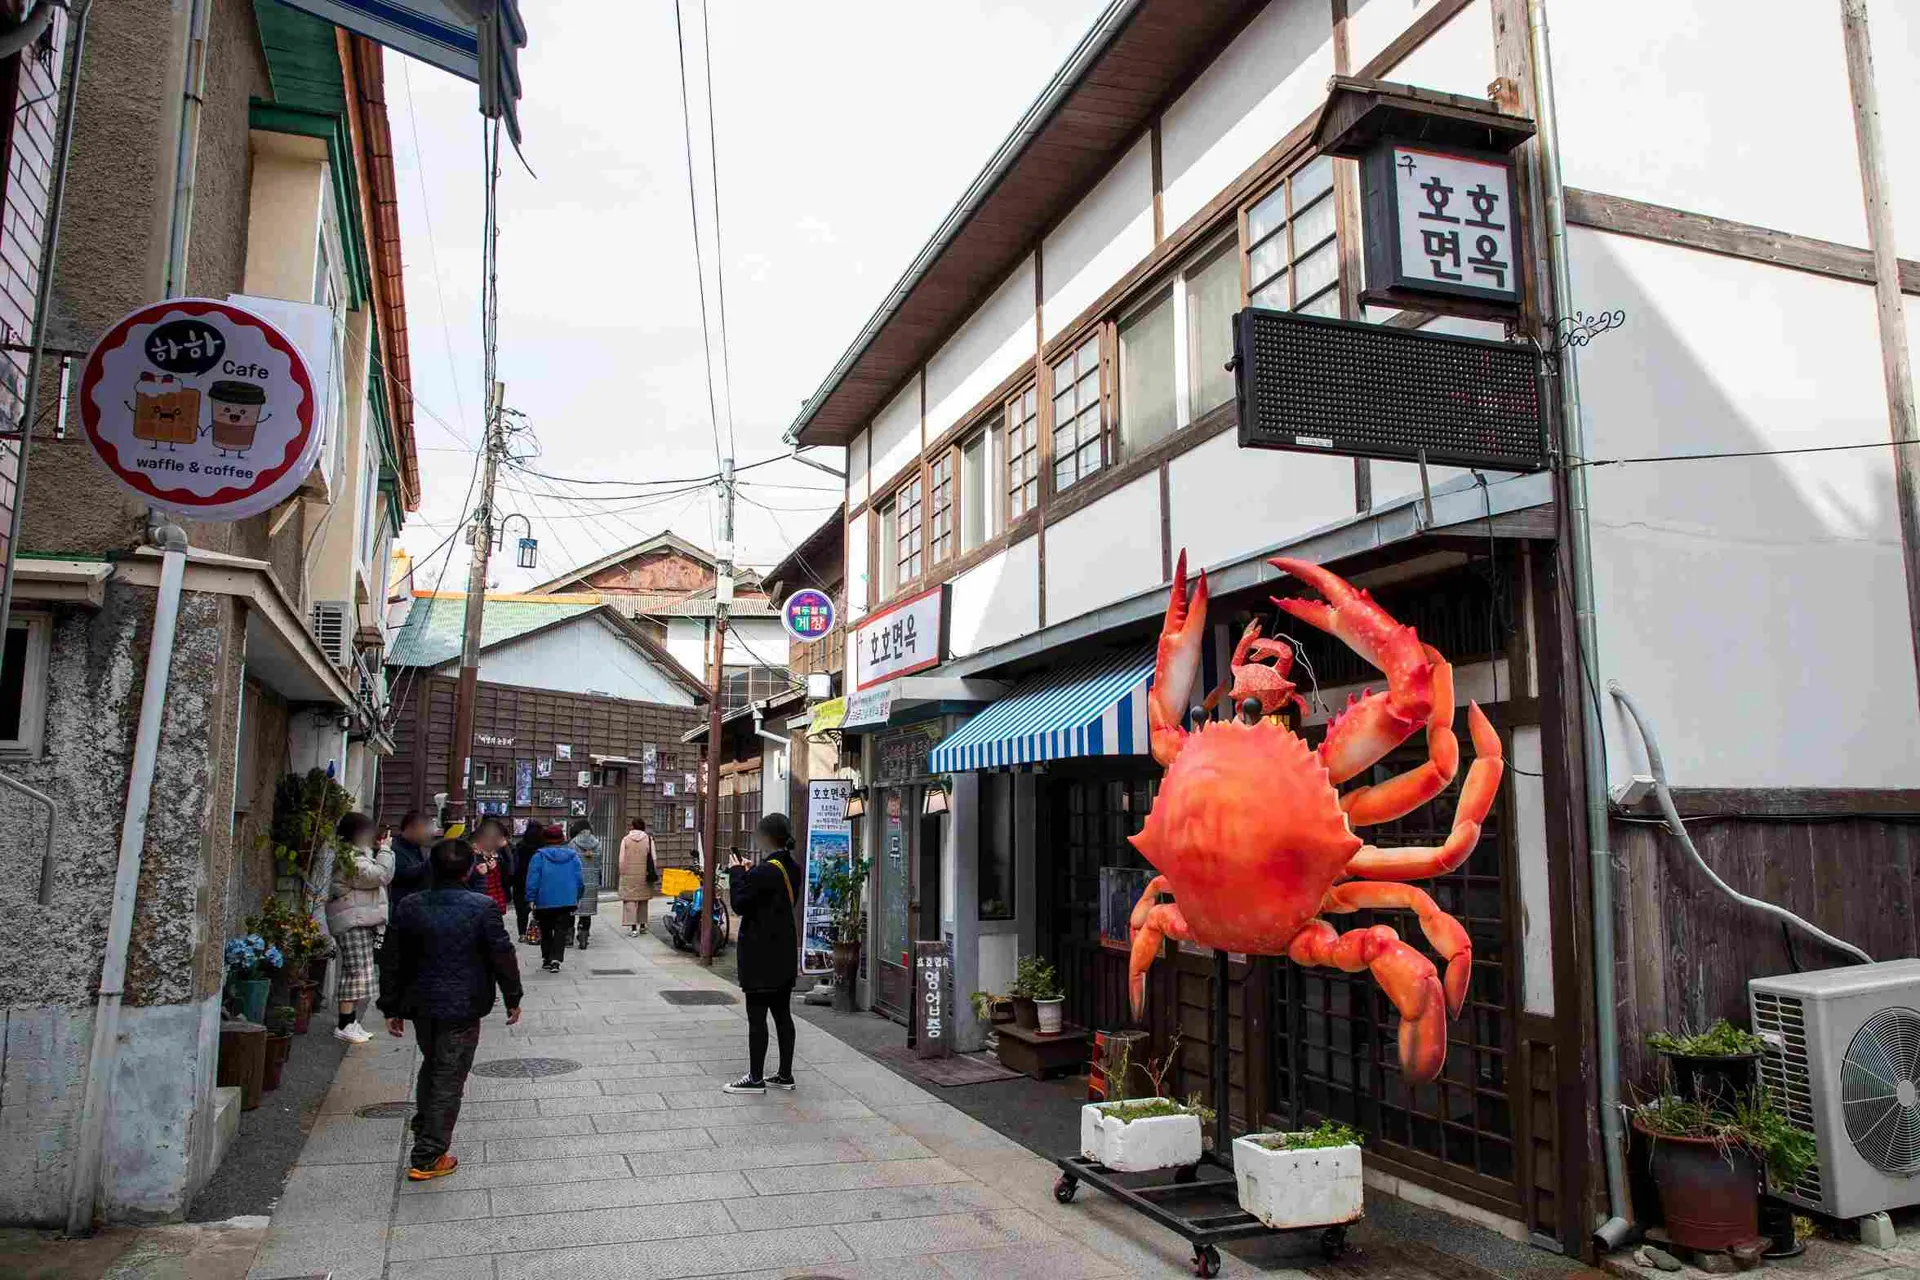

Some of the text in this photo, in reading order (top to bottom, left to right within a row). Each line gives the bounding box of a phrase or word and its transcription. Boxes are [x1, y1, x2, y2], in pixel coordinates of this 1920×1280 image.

[1396, 153, 1417, 177] 구
[1418, 176, 1506, 231] 호호
[1420, 229, 1508, 288] 면옥
[150, 329, 222, 360] 하하
[222, 359, 270, 380] Cafe
[136, 458, 254, 480] waffle & coffee
[796, 616, 826, 631] 게장
[869, 613, 918, 667] 호호면옥
[812, 786, 848, 801] 호호면옥
